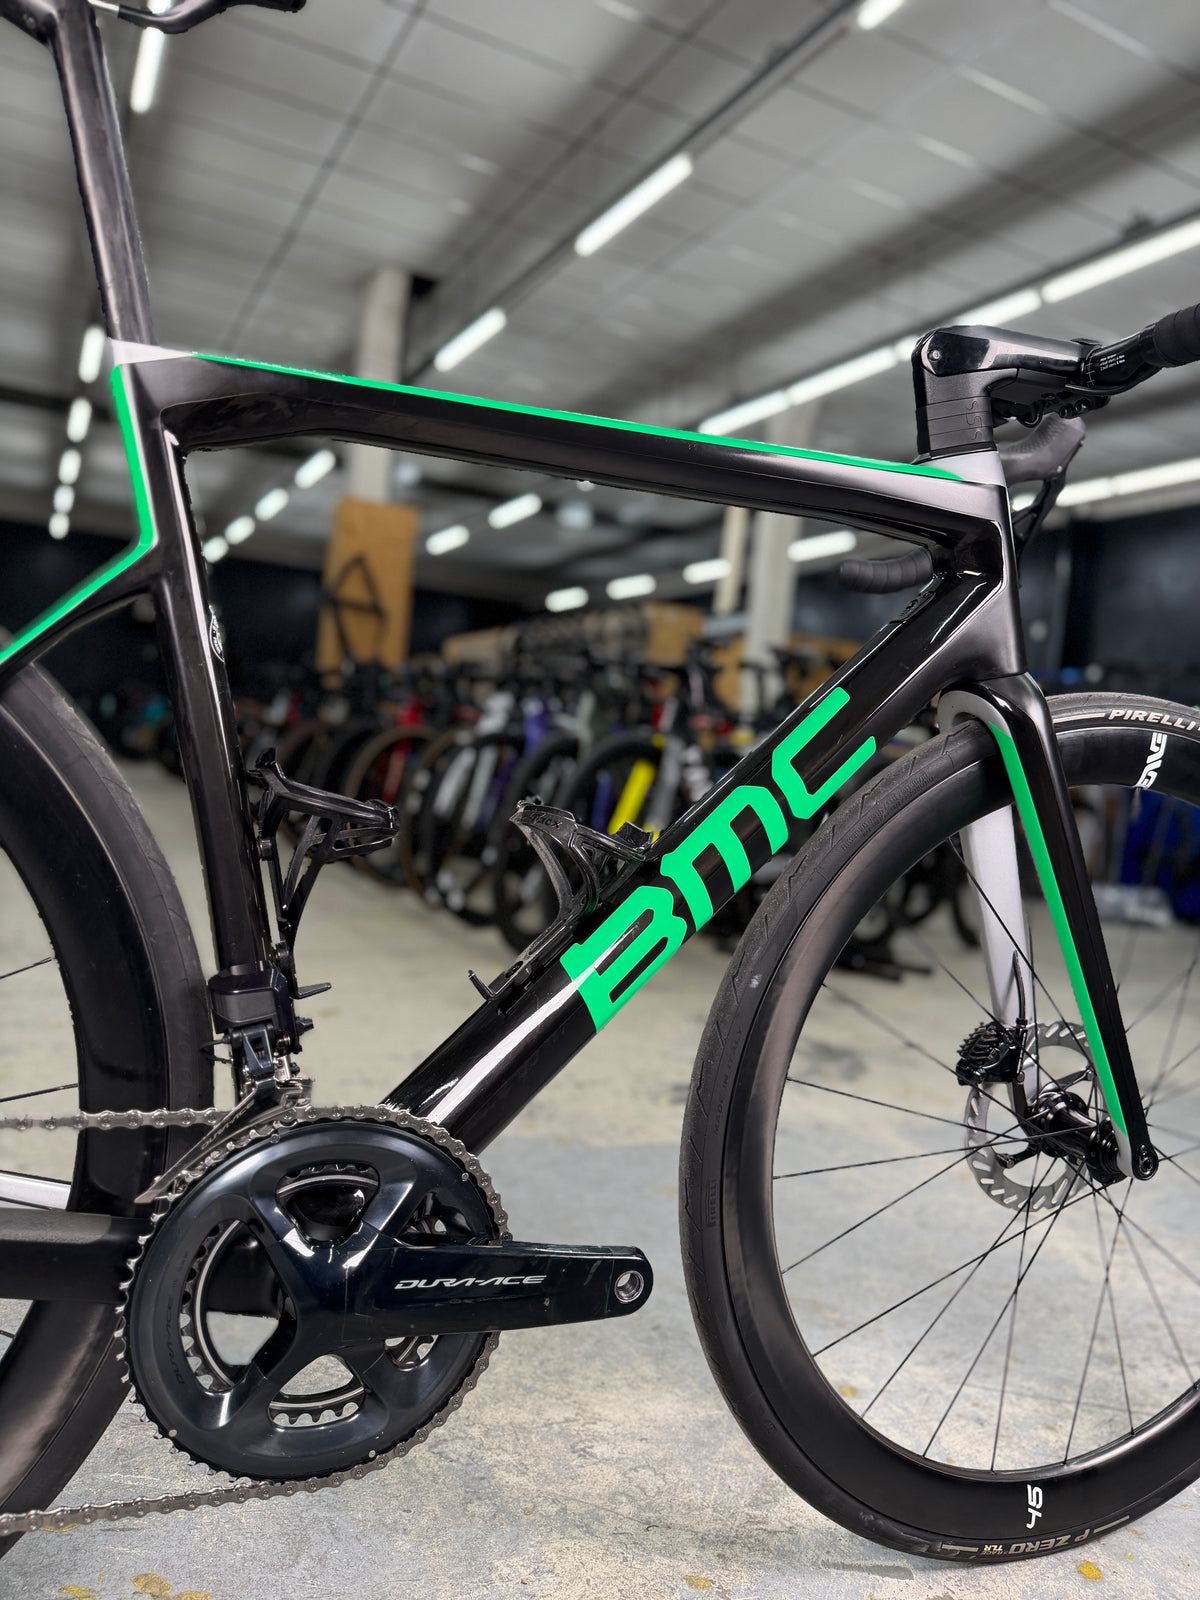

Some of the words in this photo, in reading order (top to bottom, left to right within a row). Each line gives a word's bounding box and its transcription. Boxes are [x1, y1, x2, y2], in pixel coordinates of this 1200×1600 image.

[1108, 709, 1196, 731] PIRELLI
[560, 687, 877, 1033] BMC
[394, 1275, 547, 1290] DURA-ACE
[1026, 1484, 1043, 1529] 45
[1008, 1535, 1071, 1554] ZERO
[1074, 1528, 1090, 1543] P
